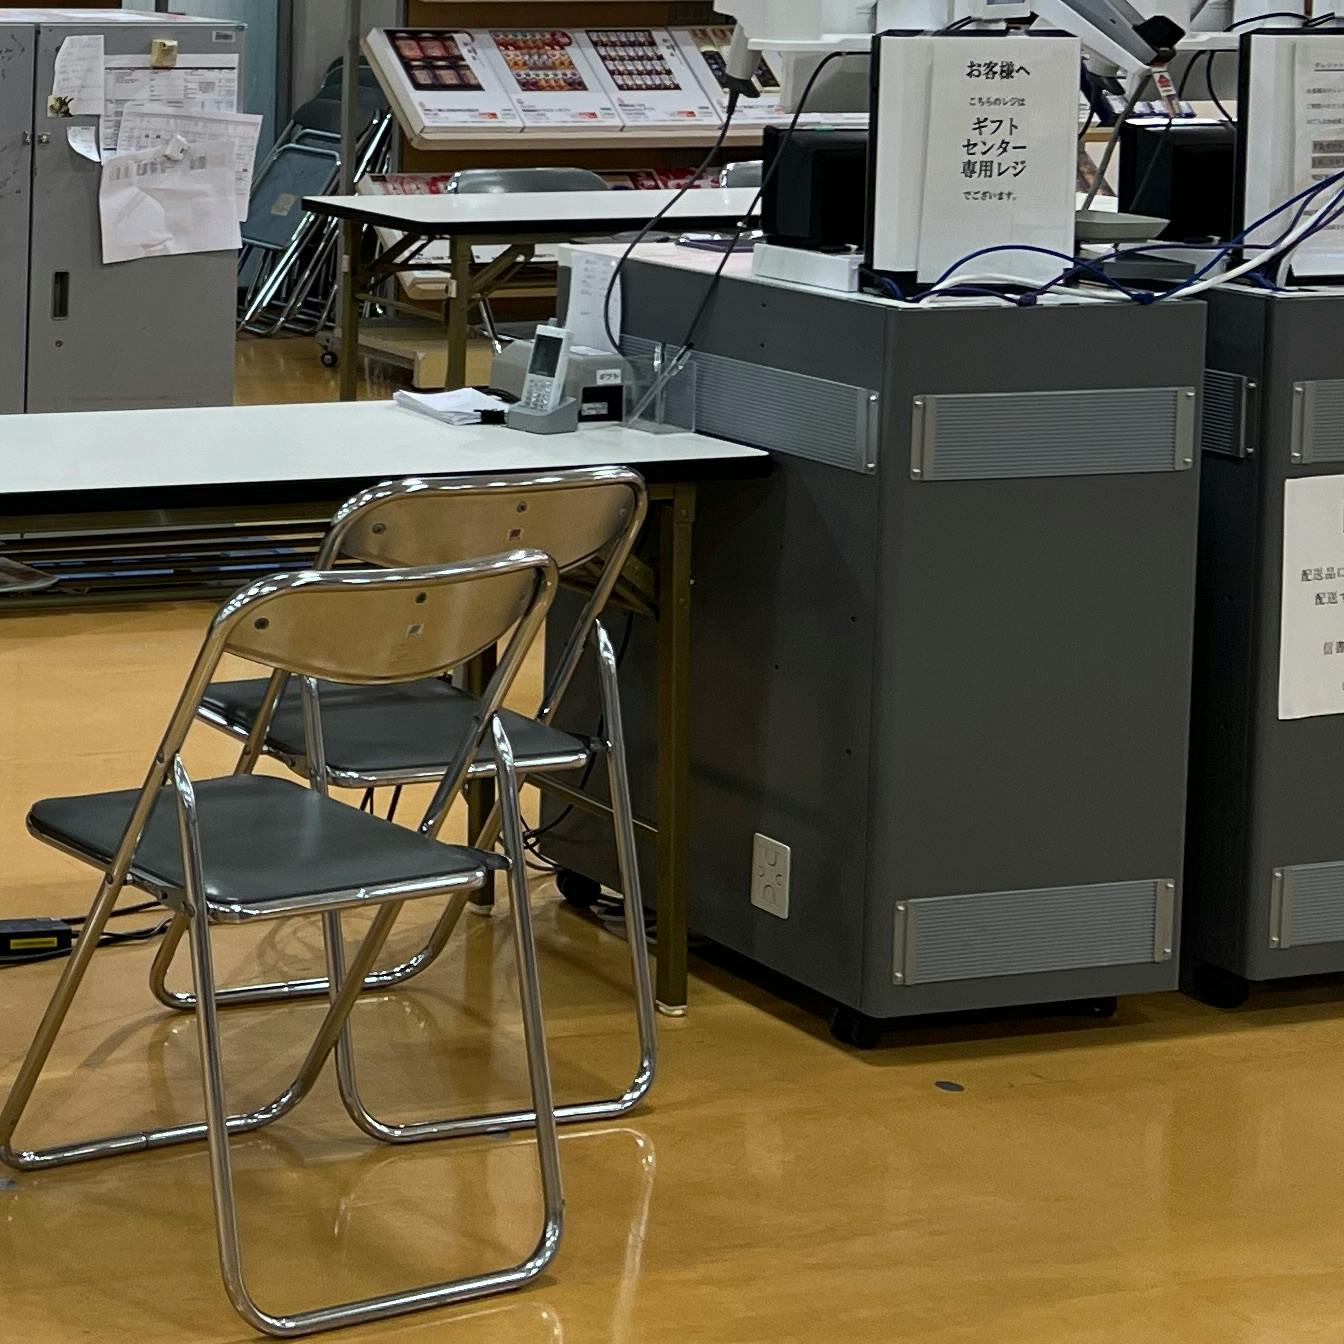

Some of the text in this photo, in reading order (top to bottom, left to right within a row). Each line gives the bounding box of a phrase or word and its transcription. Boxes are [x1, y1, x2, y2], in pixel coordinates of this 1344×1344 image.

[965, 60, 1031, 80] お客様へ
[968, 96, 1027, 107] こちらのレジは
[971, 116, 1019, 136] ギフト
[962, 138, 1028, 157] センター
[960, 159, 1027, 178] 専用レジ
